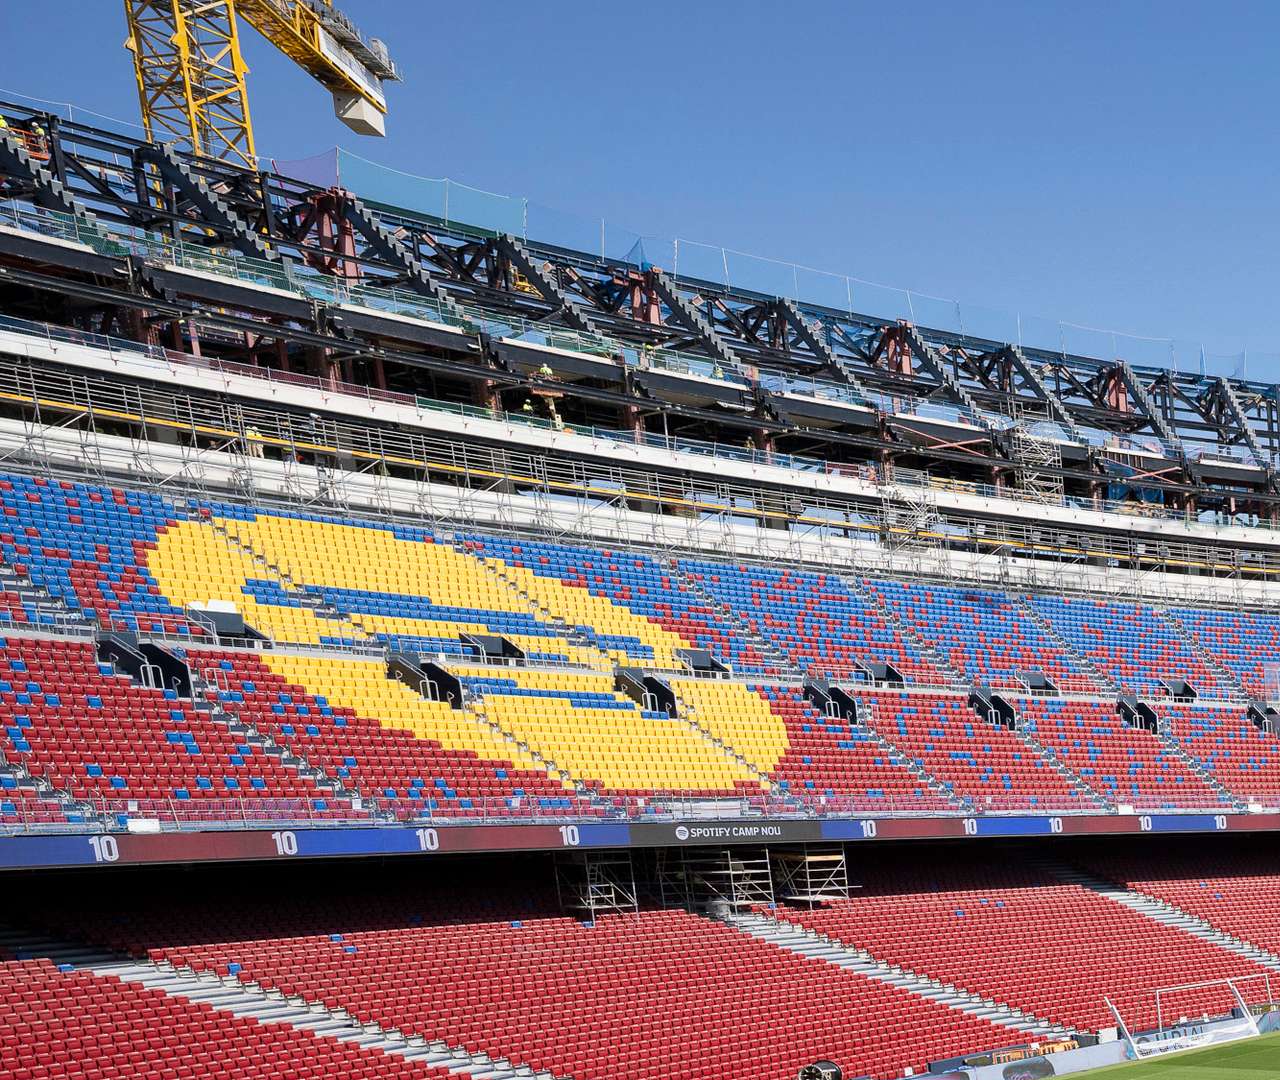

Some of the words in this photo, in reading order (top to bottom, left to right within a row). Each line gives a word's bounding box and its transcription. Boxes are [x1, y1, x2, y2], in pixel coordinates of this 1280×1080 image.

[860, 820, 877, 838] 10
[962, 818, 978, 835] 10
[1048, 817, 1063, 833] 10
[1138, 815, 1152, 831] 10
[1214, 815, 1227, 830] 10
[415, 828, 439, 851] 10
[558, 825, 580, 846] 10
[690, 827, 731, 838] SPOTIFY
[732, 826, 760, 837] CAMP
[761, 826, 782, 836] NOU
[88, 835, 120, 862] 10
[271, 831, 298, 855] 10
